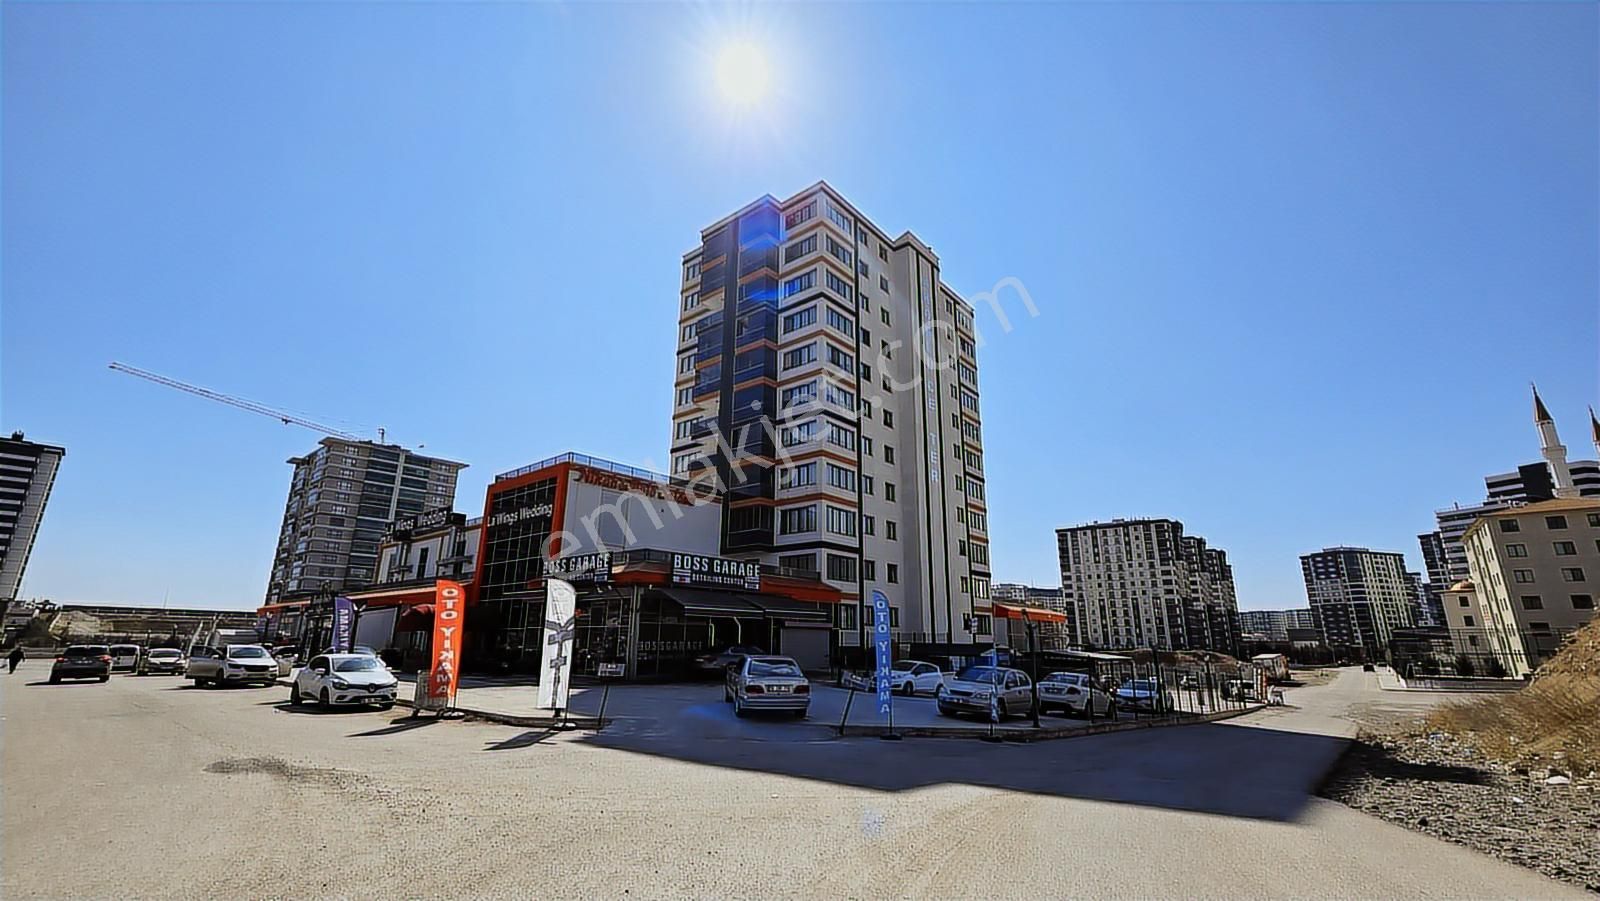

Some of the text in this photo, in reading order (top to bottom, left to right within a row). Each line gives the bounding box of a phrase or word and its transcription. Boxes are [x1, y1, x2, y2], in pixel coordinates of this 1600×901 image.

[519, 503, 553, 520] Wedding
[543, 553, 610, 575] BOSS GARAGE
[674, 554, 760, 577] BOSS GARAGE
